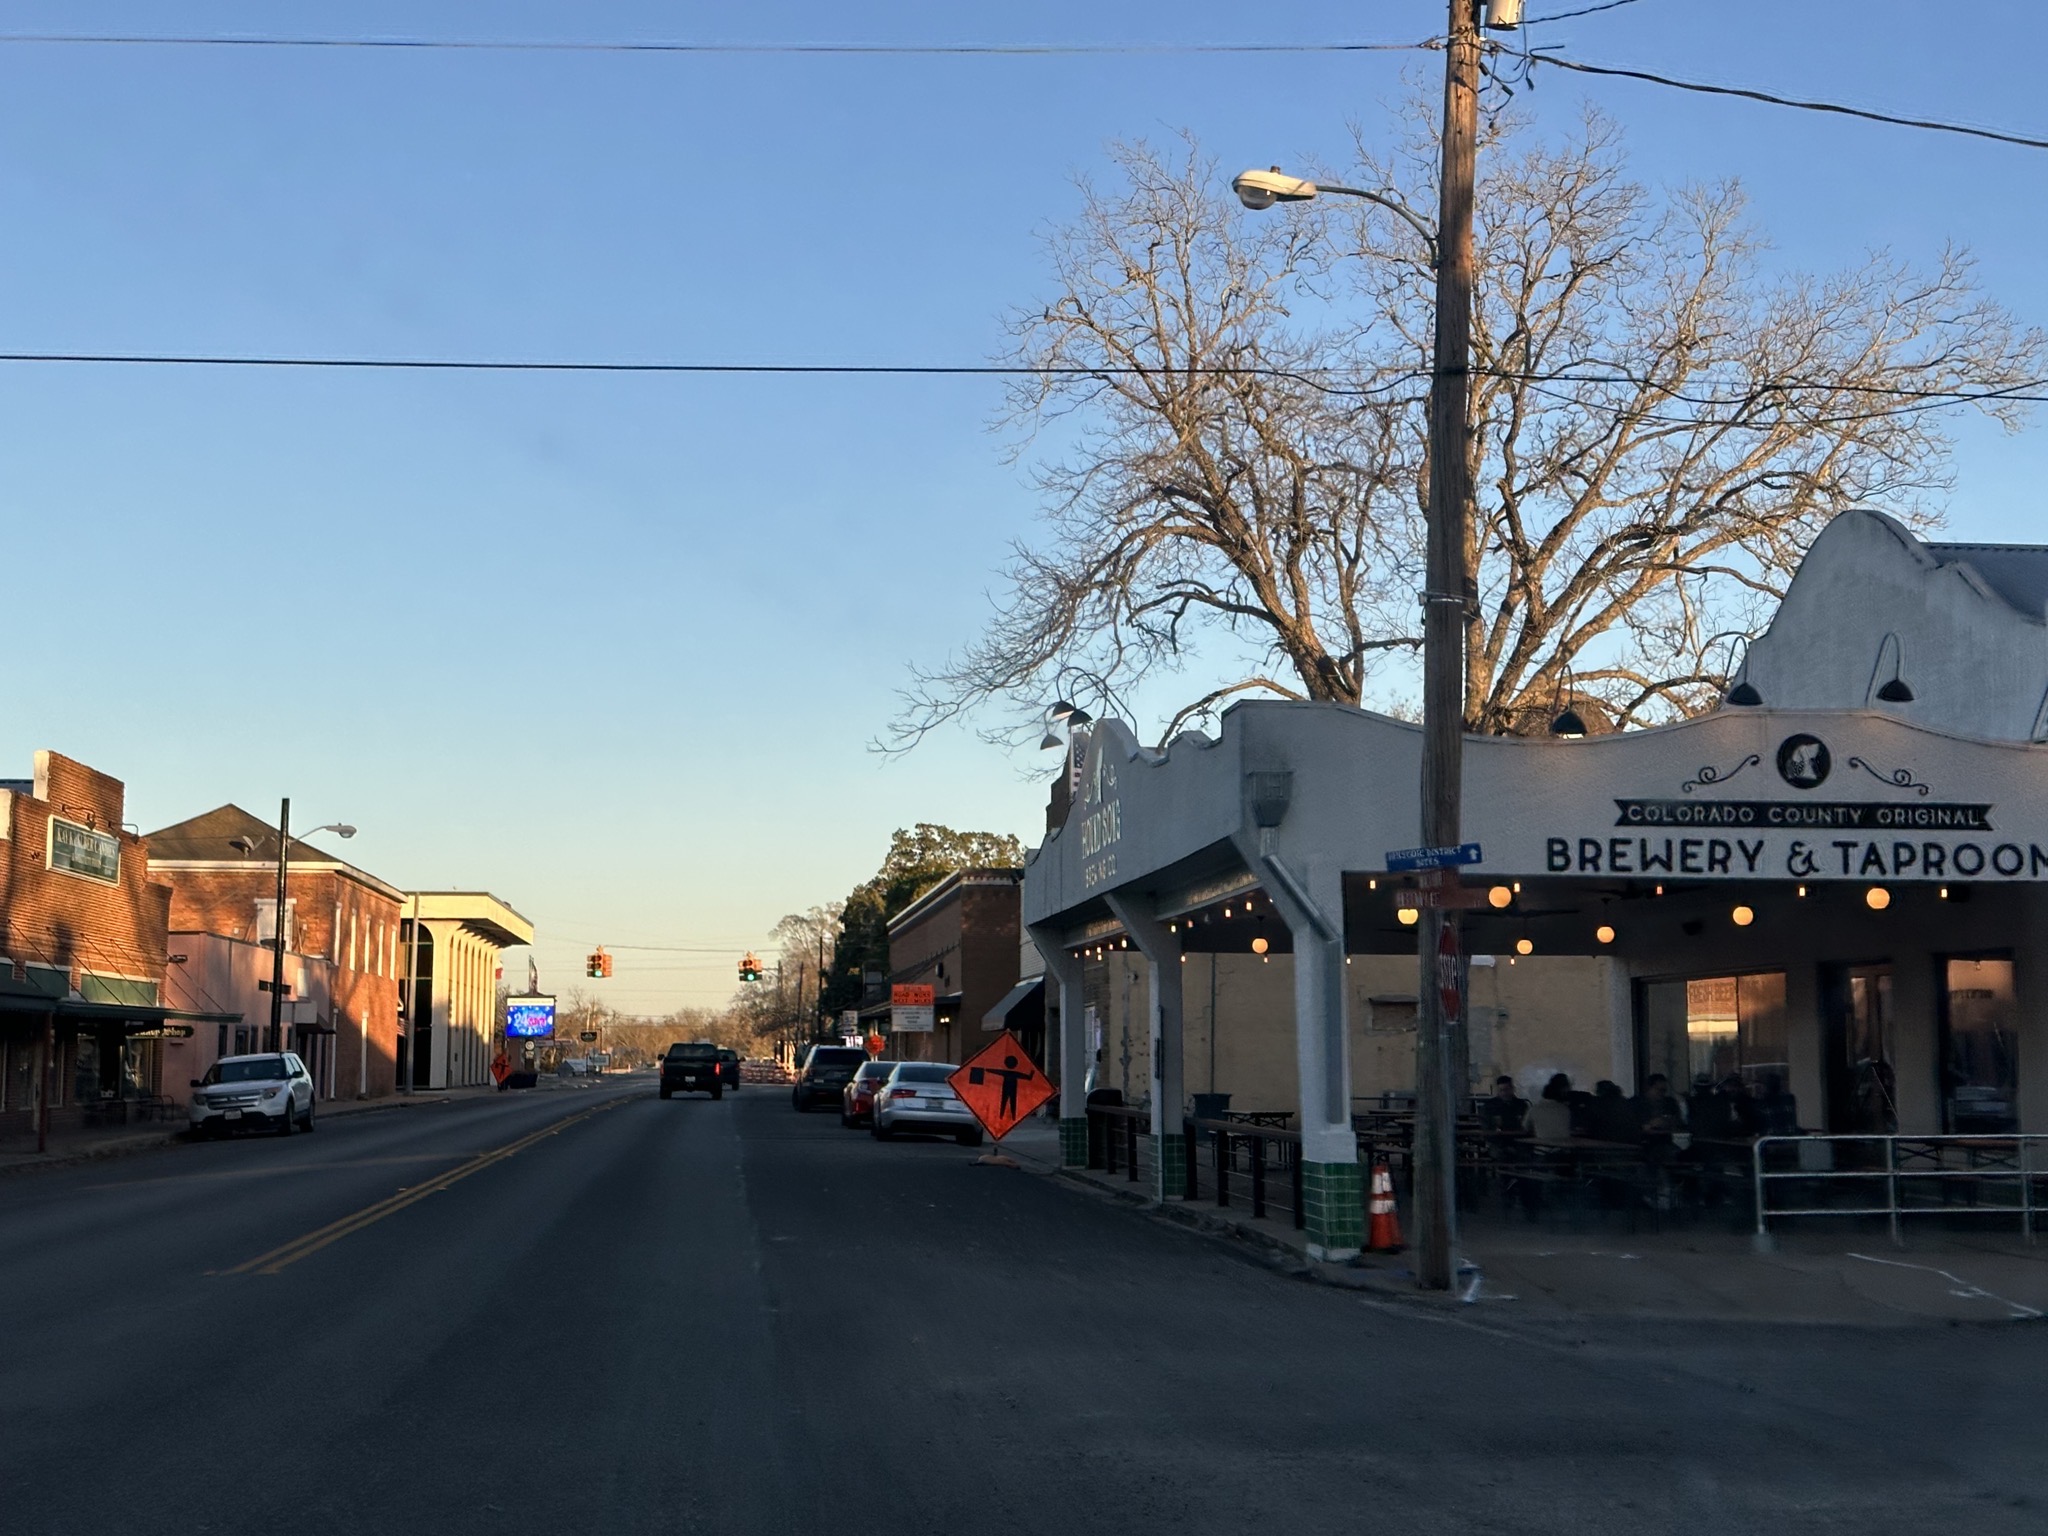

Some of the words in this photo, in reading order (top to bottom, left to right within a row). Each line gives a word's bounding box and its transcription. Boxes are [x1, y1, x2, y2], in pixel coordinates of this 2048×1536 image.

[1626, 804, 1755, 823] COLORADO
[1768, 806, 1863, 824] COUNTY
[1877, 808, 1981, 826] ORIGINAL
[1546, 837, 1765, 873] BREWERY
[1786, 839, 1821, 876] &
